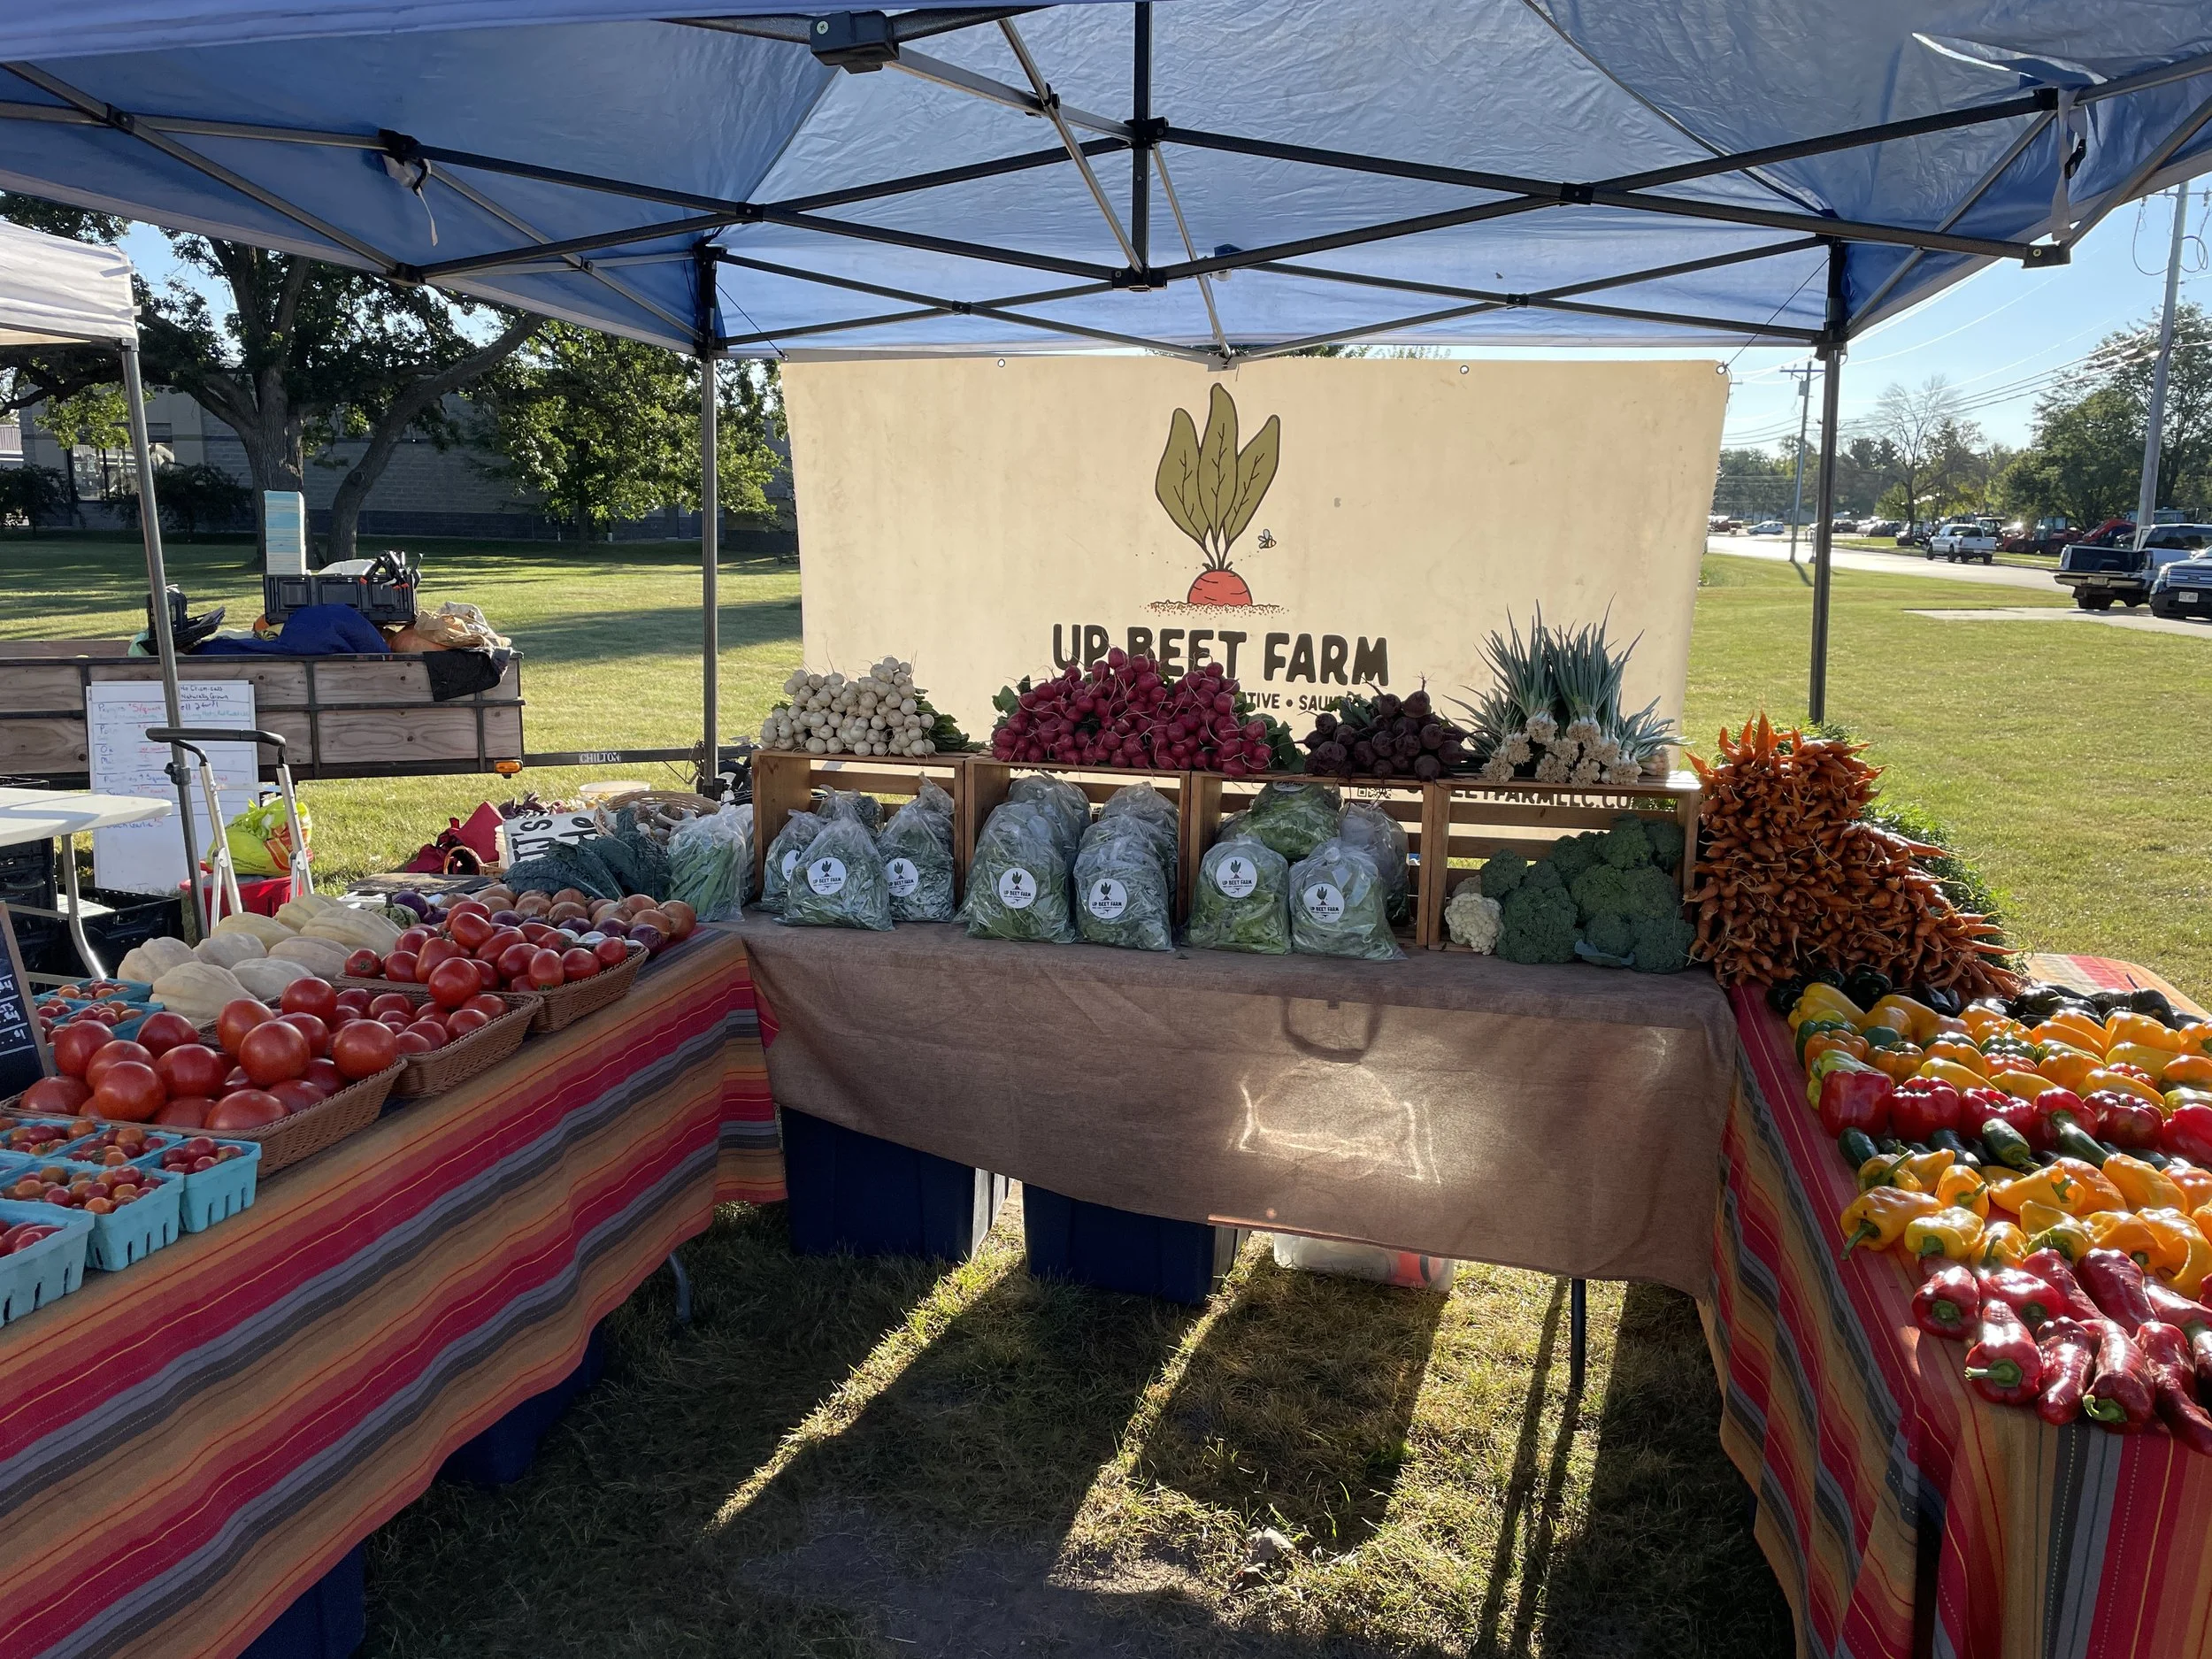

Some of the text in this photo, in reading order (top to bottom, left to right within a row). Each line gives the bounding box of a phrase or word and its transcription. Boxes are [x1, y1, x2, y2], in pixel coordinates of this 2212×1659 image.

[1053, 624, 1389, 687] UP BEET FARM
[580, 752, 621, 763] CHILTON
